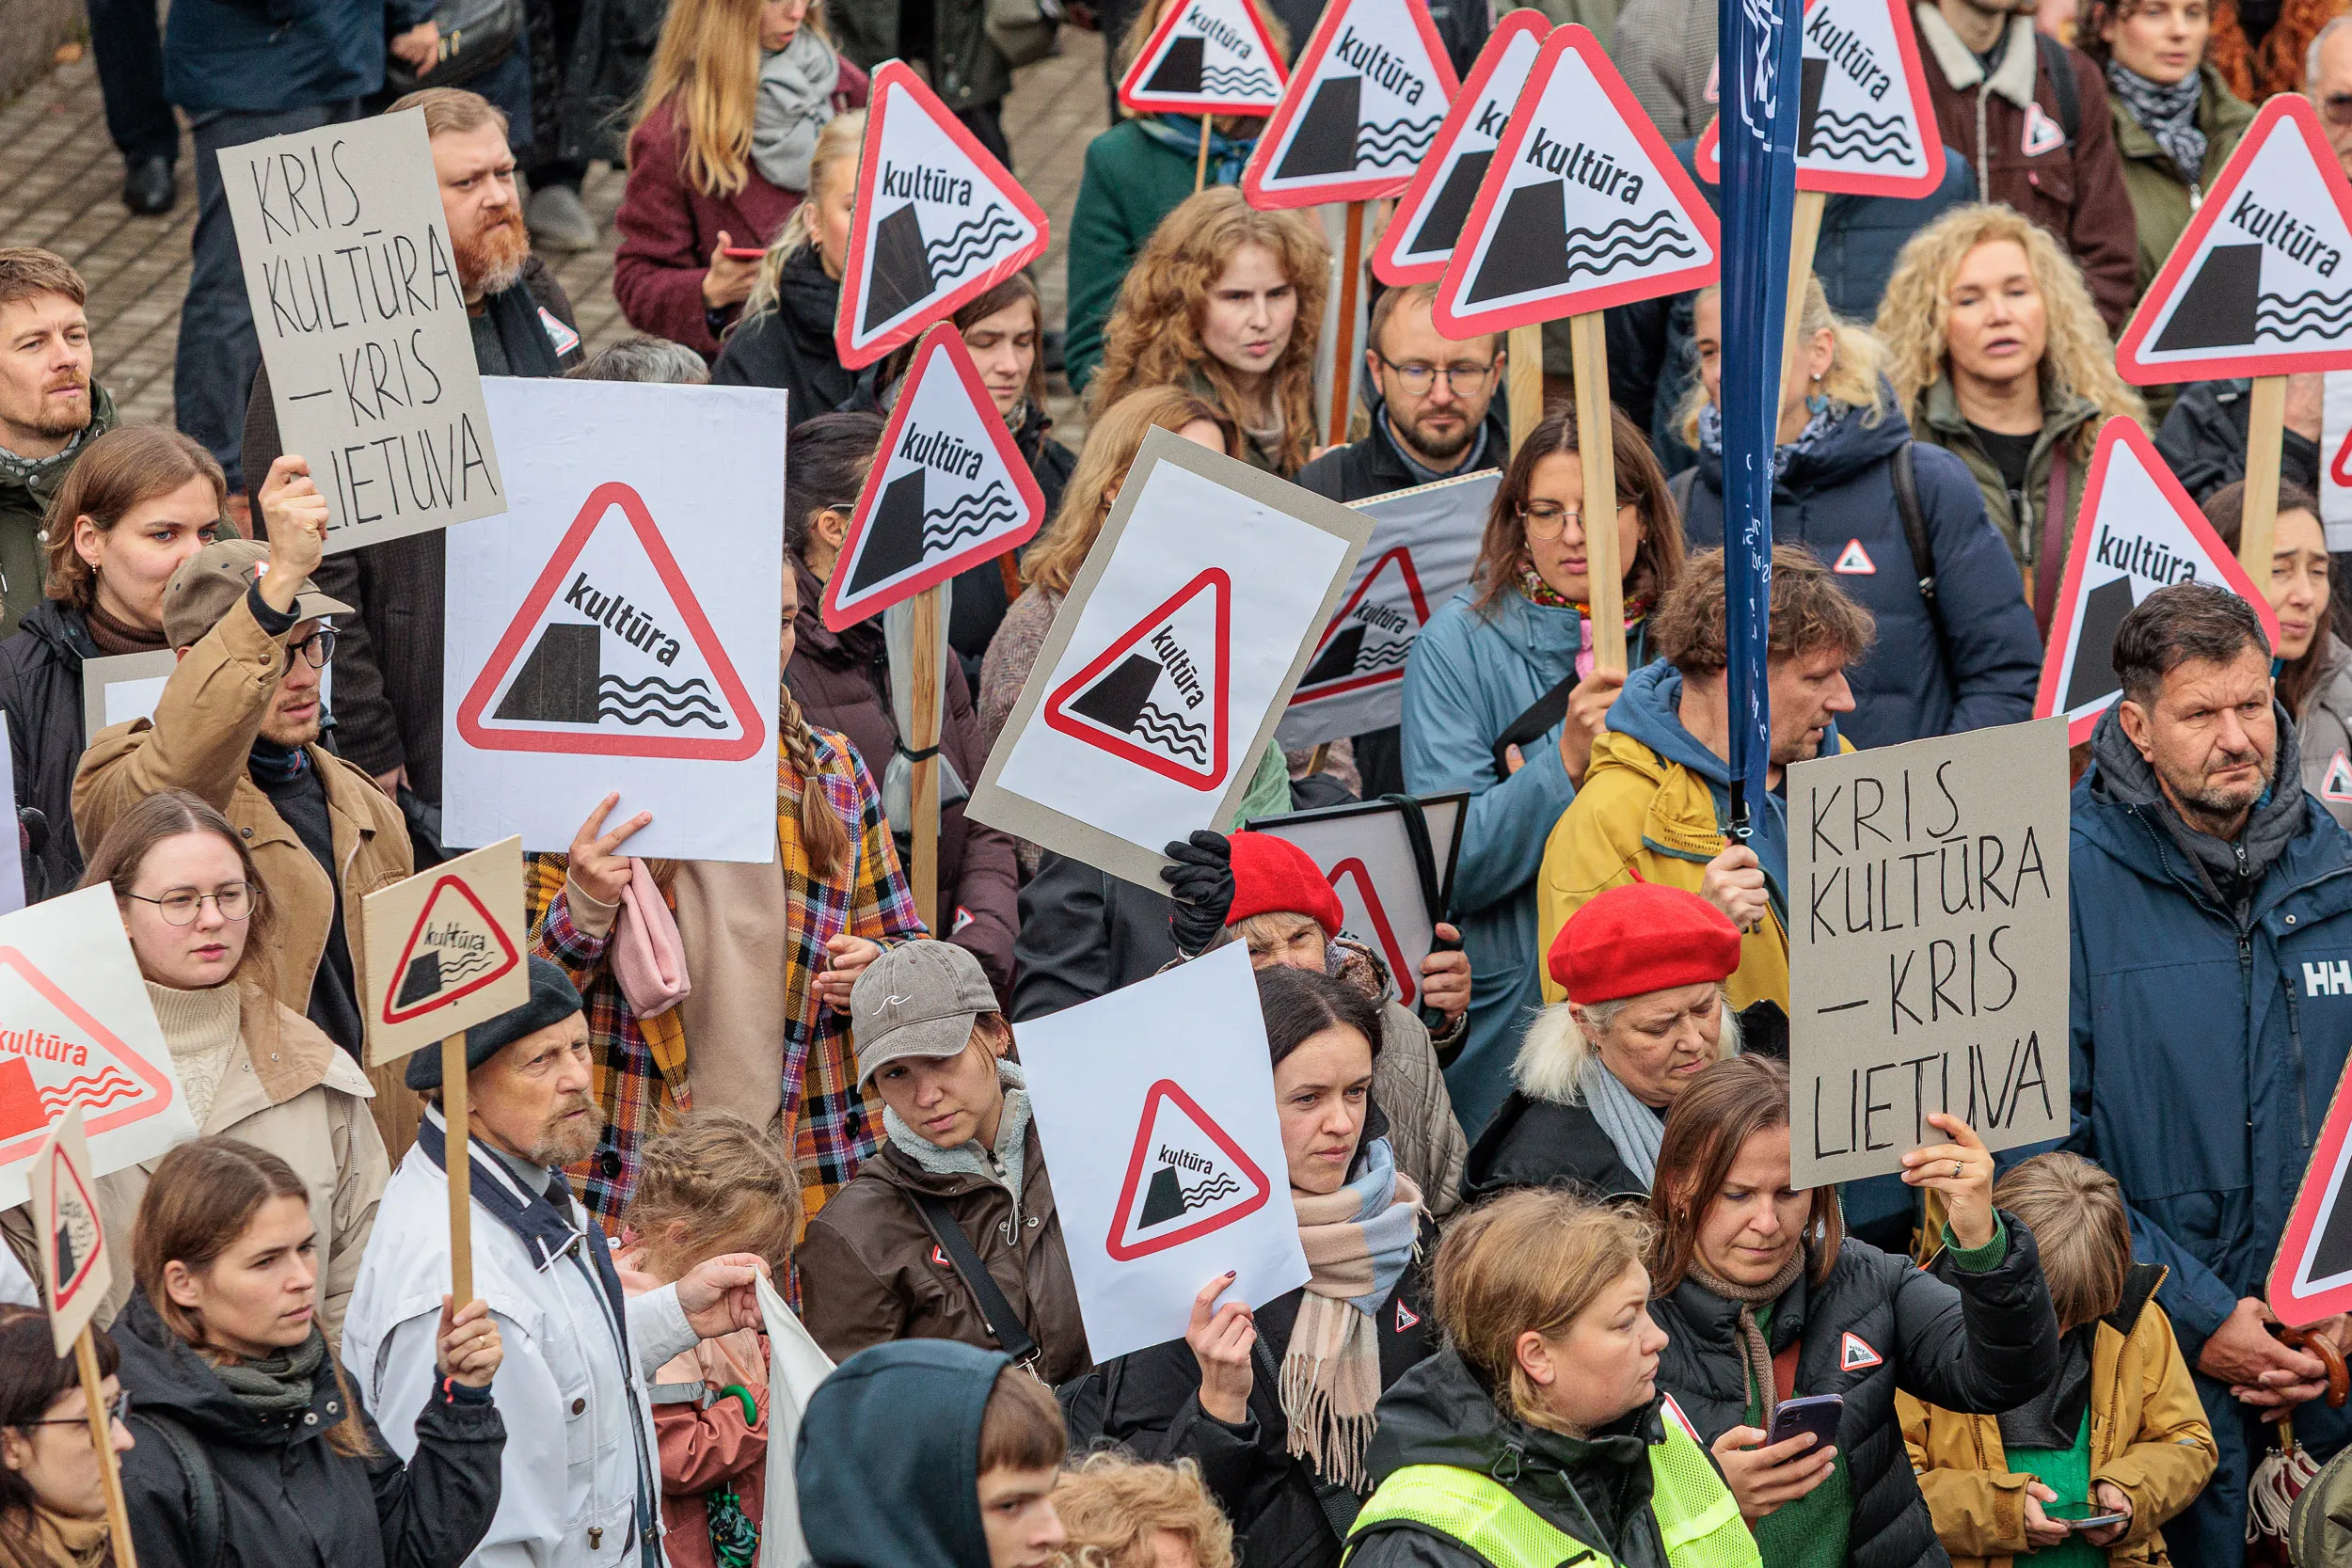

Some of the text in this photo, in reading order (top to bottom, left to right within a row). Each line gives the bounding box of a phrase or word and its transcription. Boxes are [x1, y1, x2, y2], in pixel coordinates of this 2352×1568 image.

[1185, 4, 1256, 60] kultūra
[1336, 26, 1426, 105] kultūra
[1805, 6, 1892, 103] kultūra
[251, 140, 361, 244] KRIS
[882, 161, 972, 206] kultūra
[1526, 127, 1644, 205] kultūra
[2231, 191, 2342, 277] kultūra
[262, 224, 464, 338] KULTŪRA
[326, 413, 497, 531] IETUVA
[900, 423, 983, 481] kultūra
[564, 573, 681, 667] kultūra
[1355, 600, 1407, 634] kultūra
[1151, 626, 1207, 711] kultūra
[1810, 759, 1962, 863] KRIS
[1809, 824, 2052, 945] KULTŪRA
[423, 922, 485, 951] kultūra
[2301, 959, 2352, 998] HH
[1159, 1145, 1214, 1175] kultūra
